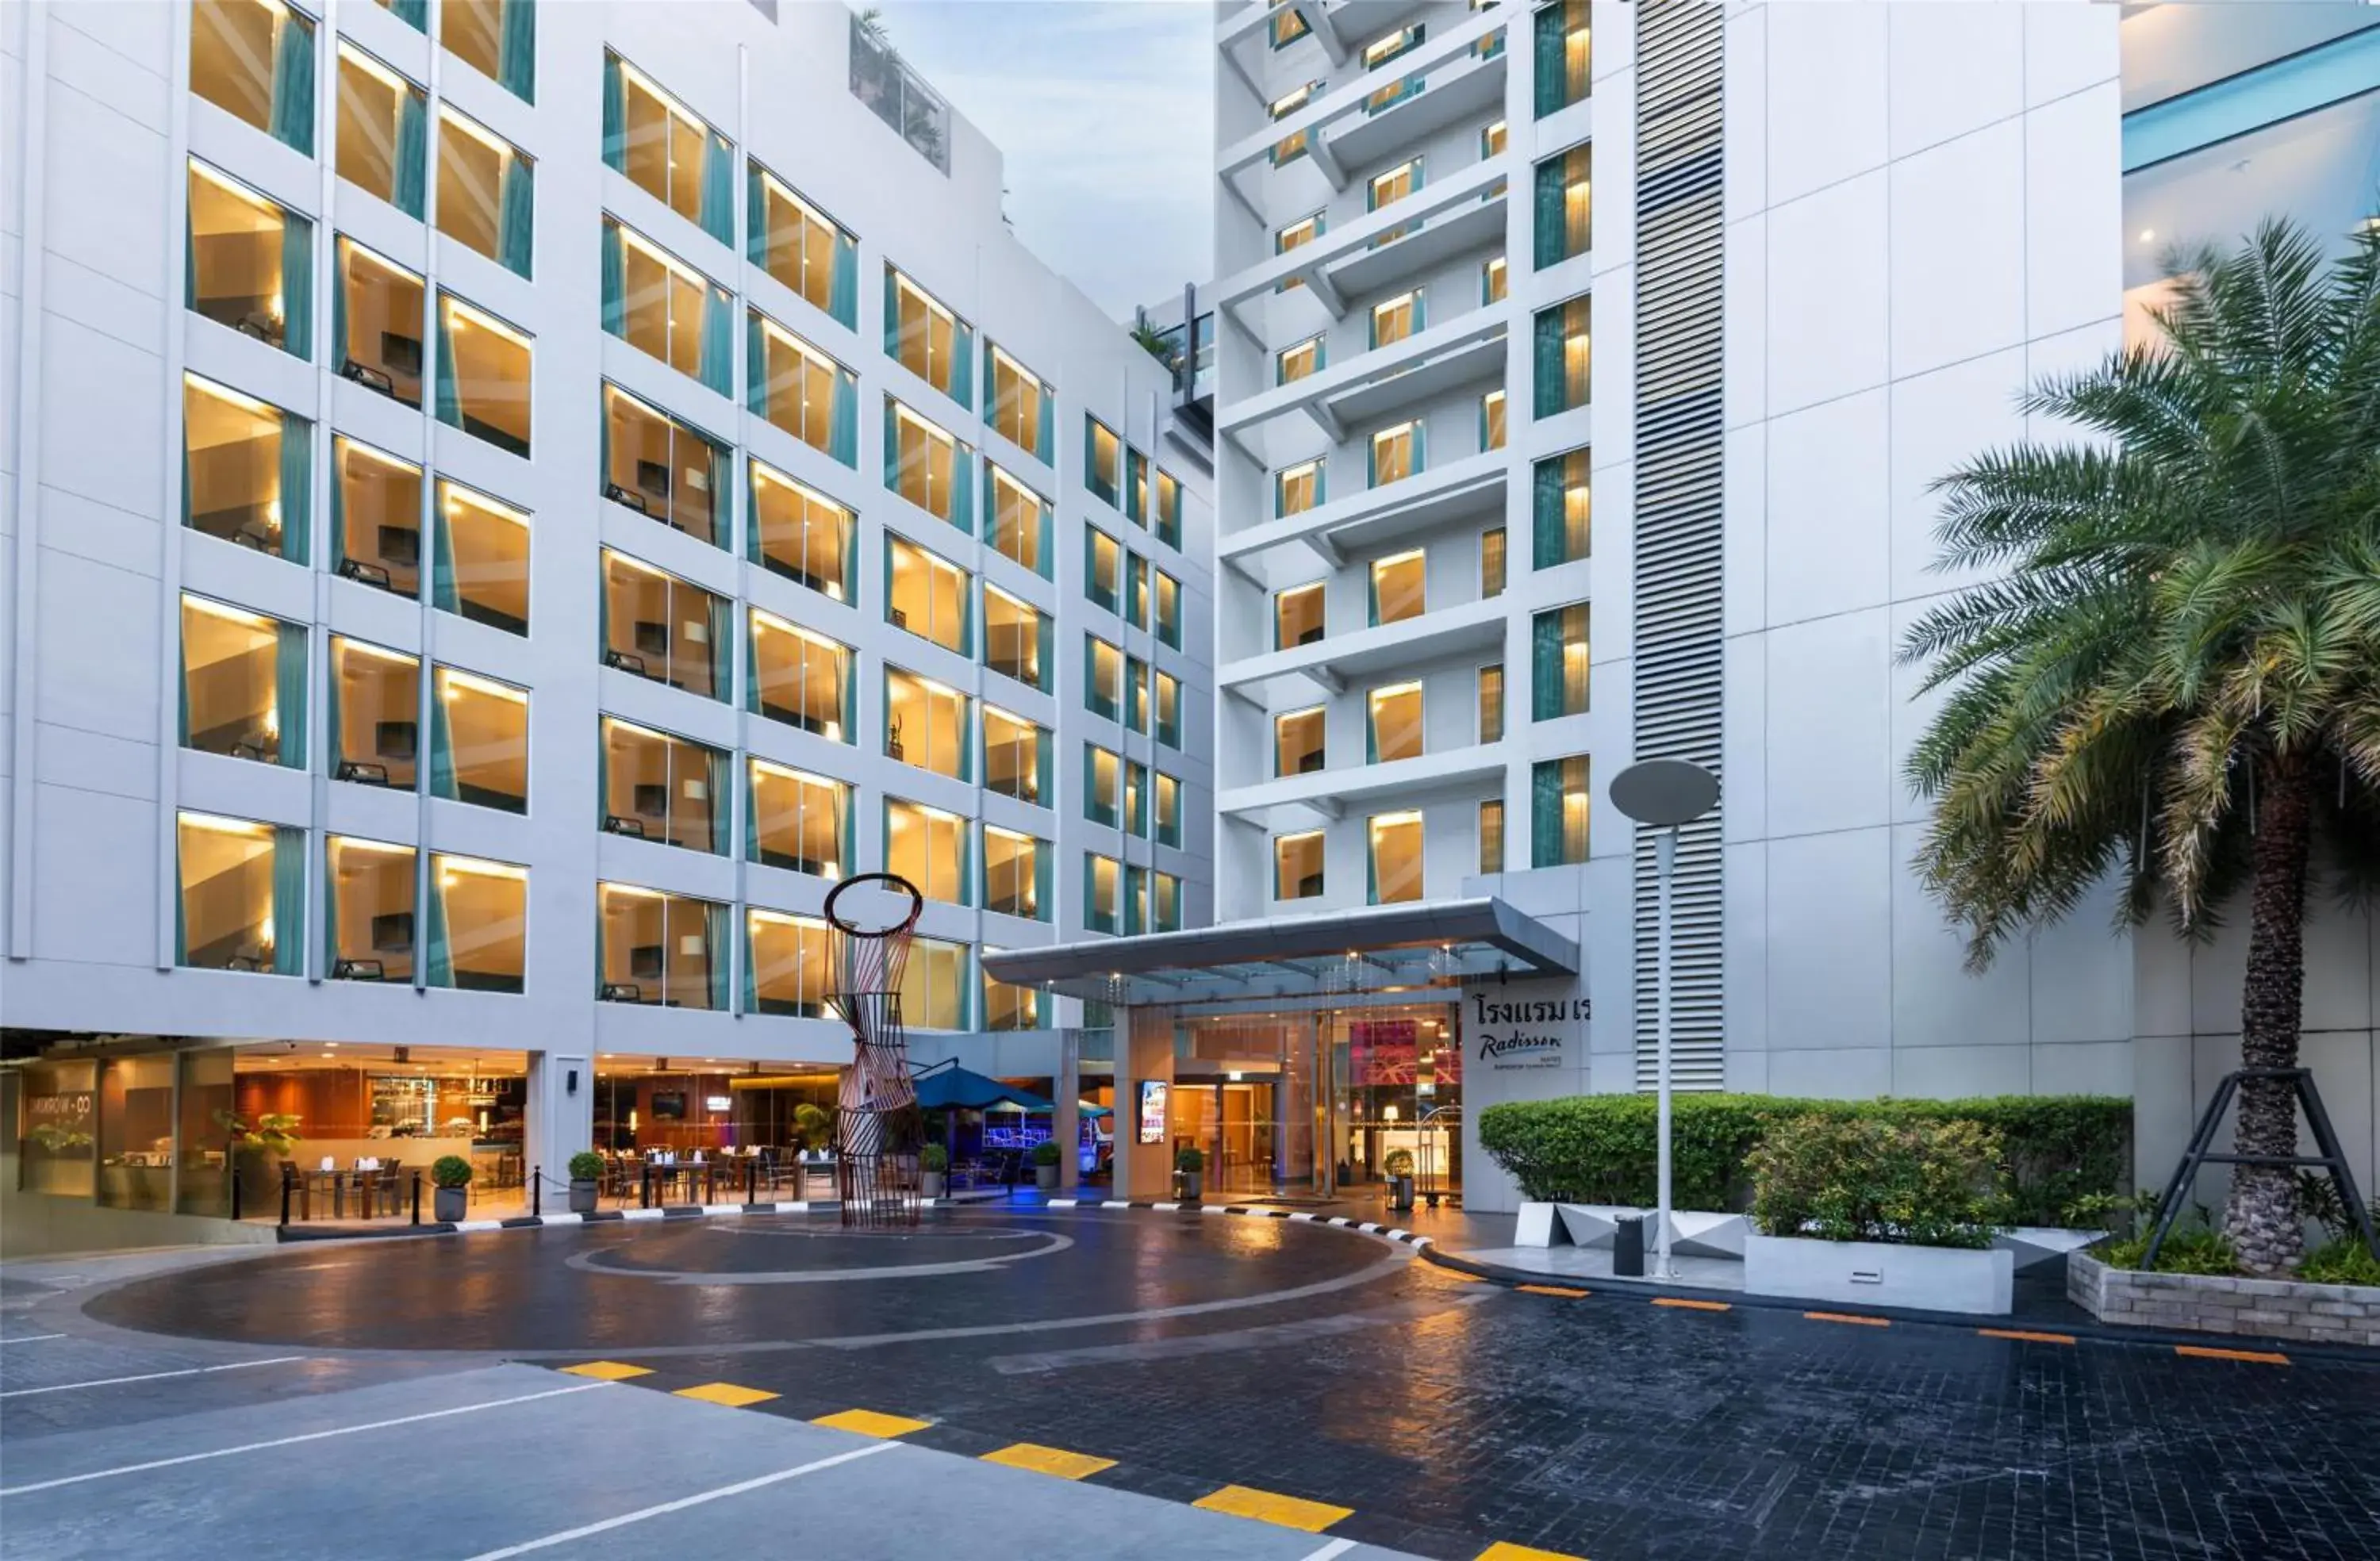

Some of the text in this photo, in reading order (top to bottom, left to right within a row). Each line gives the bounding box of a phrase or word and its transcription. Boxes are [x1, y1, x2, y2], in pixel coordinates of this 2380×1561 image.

[1472, 993, 1565, 1024] โรงแรม
[1479, 1030, 1561, 1060] Radisson
